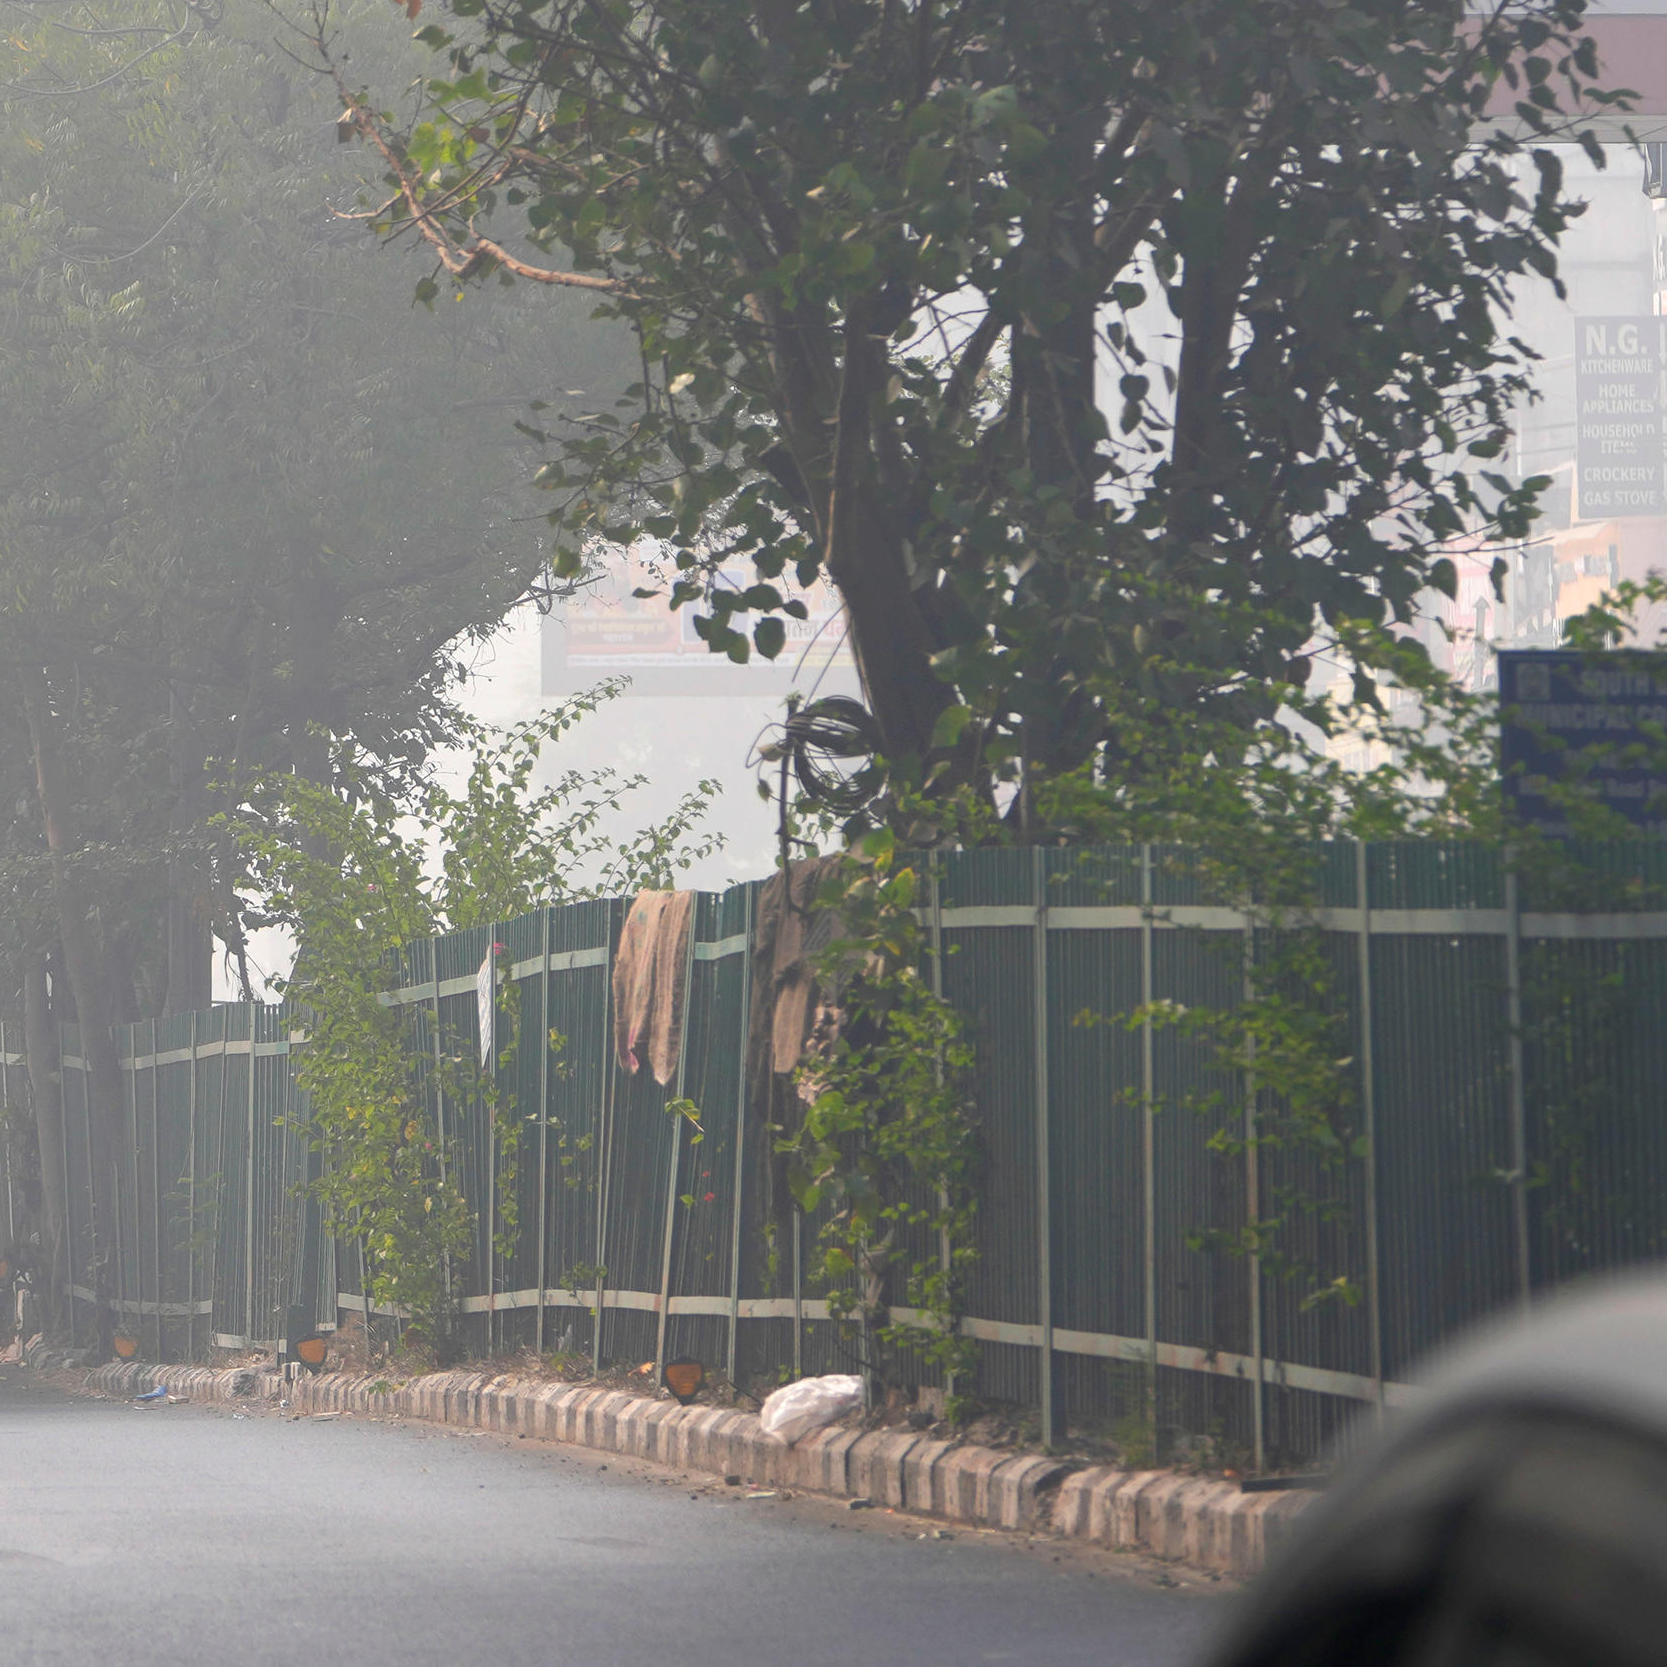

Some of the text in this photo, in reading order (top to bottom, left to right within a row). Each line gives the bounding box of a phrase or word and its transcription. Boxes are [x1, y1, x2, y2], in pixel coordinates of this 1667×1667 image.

[1586, 323, 1648, 355] N.G.
[1580, 358, 1654, 375] KITCHENWARE
[1598, 383, 1636, 399] HOME
[1583, 399, 1654, 415] APPLIANCES
[1584, 466, 1656, 482] CROCKERY
[1584, 490, 1656, 506] GAS STOVE
